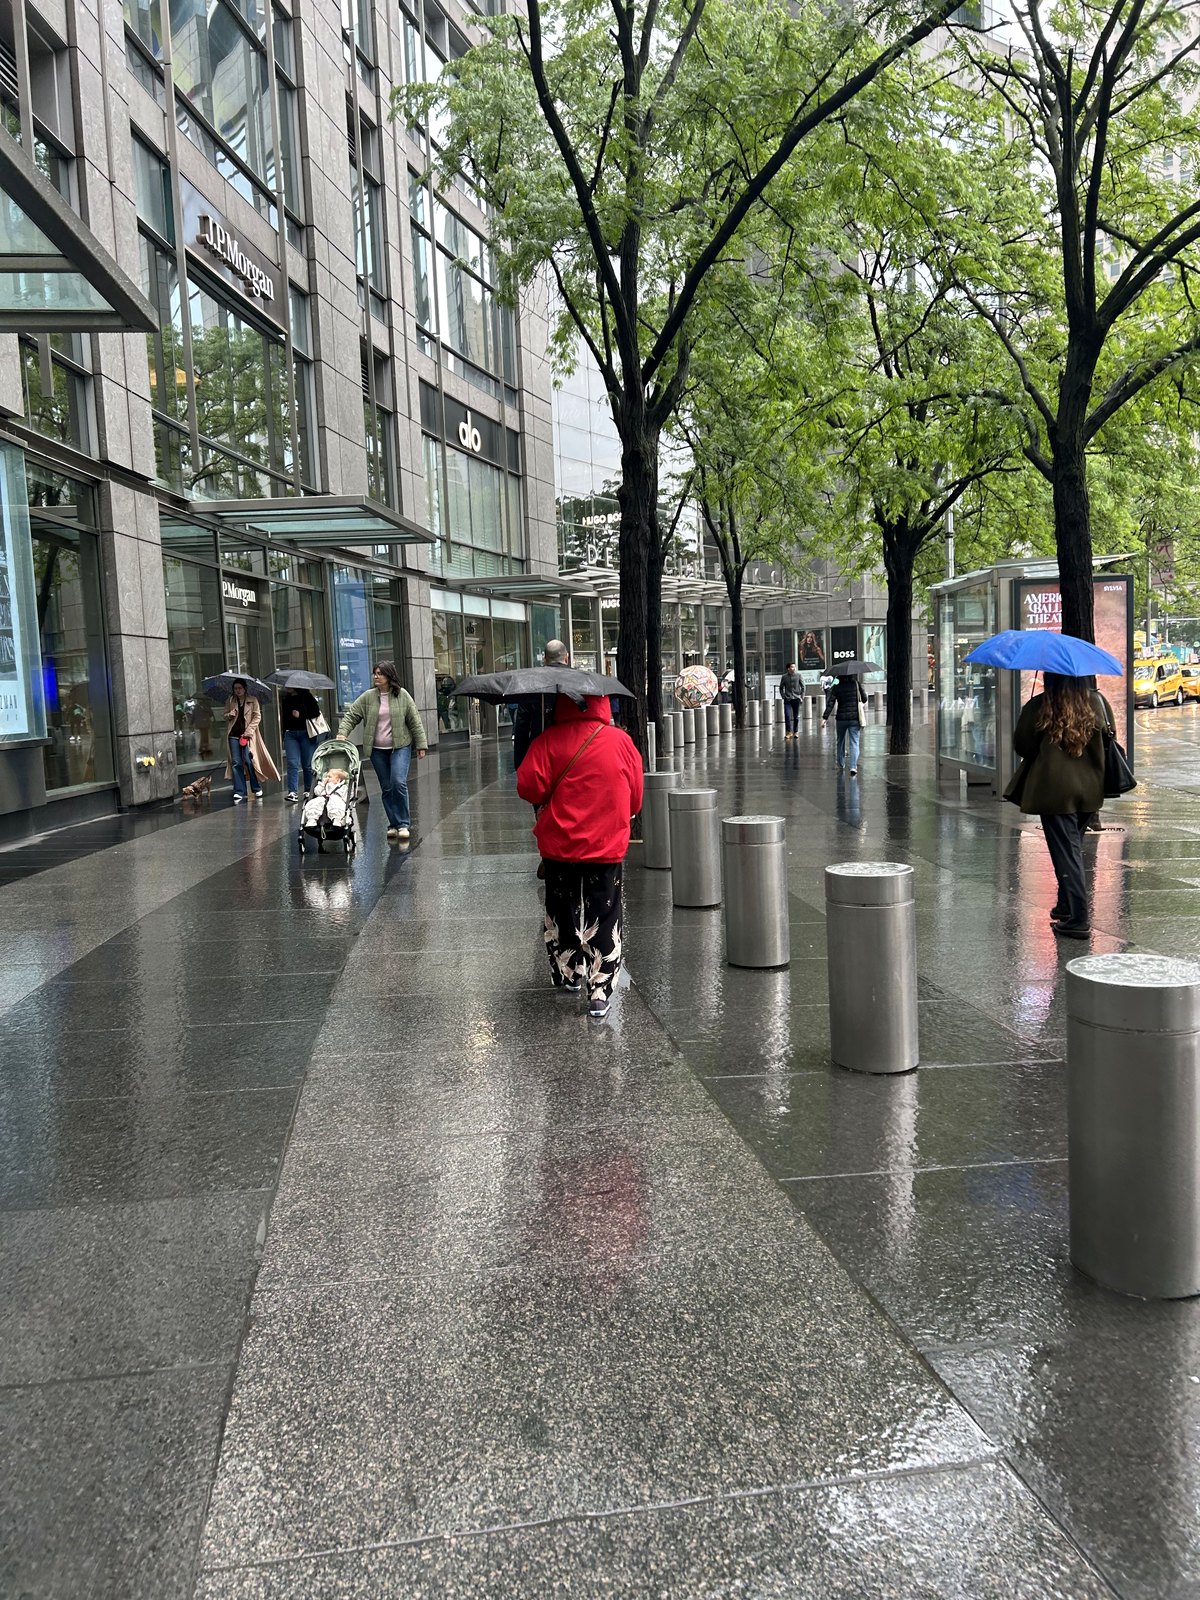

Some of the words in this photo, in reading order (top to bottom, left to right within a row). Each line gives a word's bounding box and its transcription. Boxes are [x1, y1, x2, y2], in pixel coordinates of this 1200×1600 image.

[202, 214, 275, 301] J.P.Morgan
[459, 409, 482, 453] alo
[582, 514, 606, 526] HUGO
[1023, 592, 1062, 605] AMERI
[1028, 602, 1062, 614] BALL
[1026, 613, 1062, 625] THEAT
[833, 650, 855, 658] BOSS
